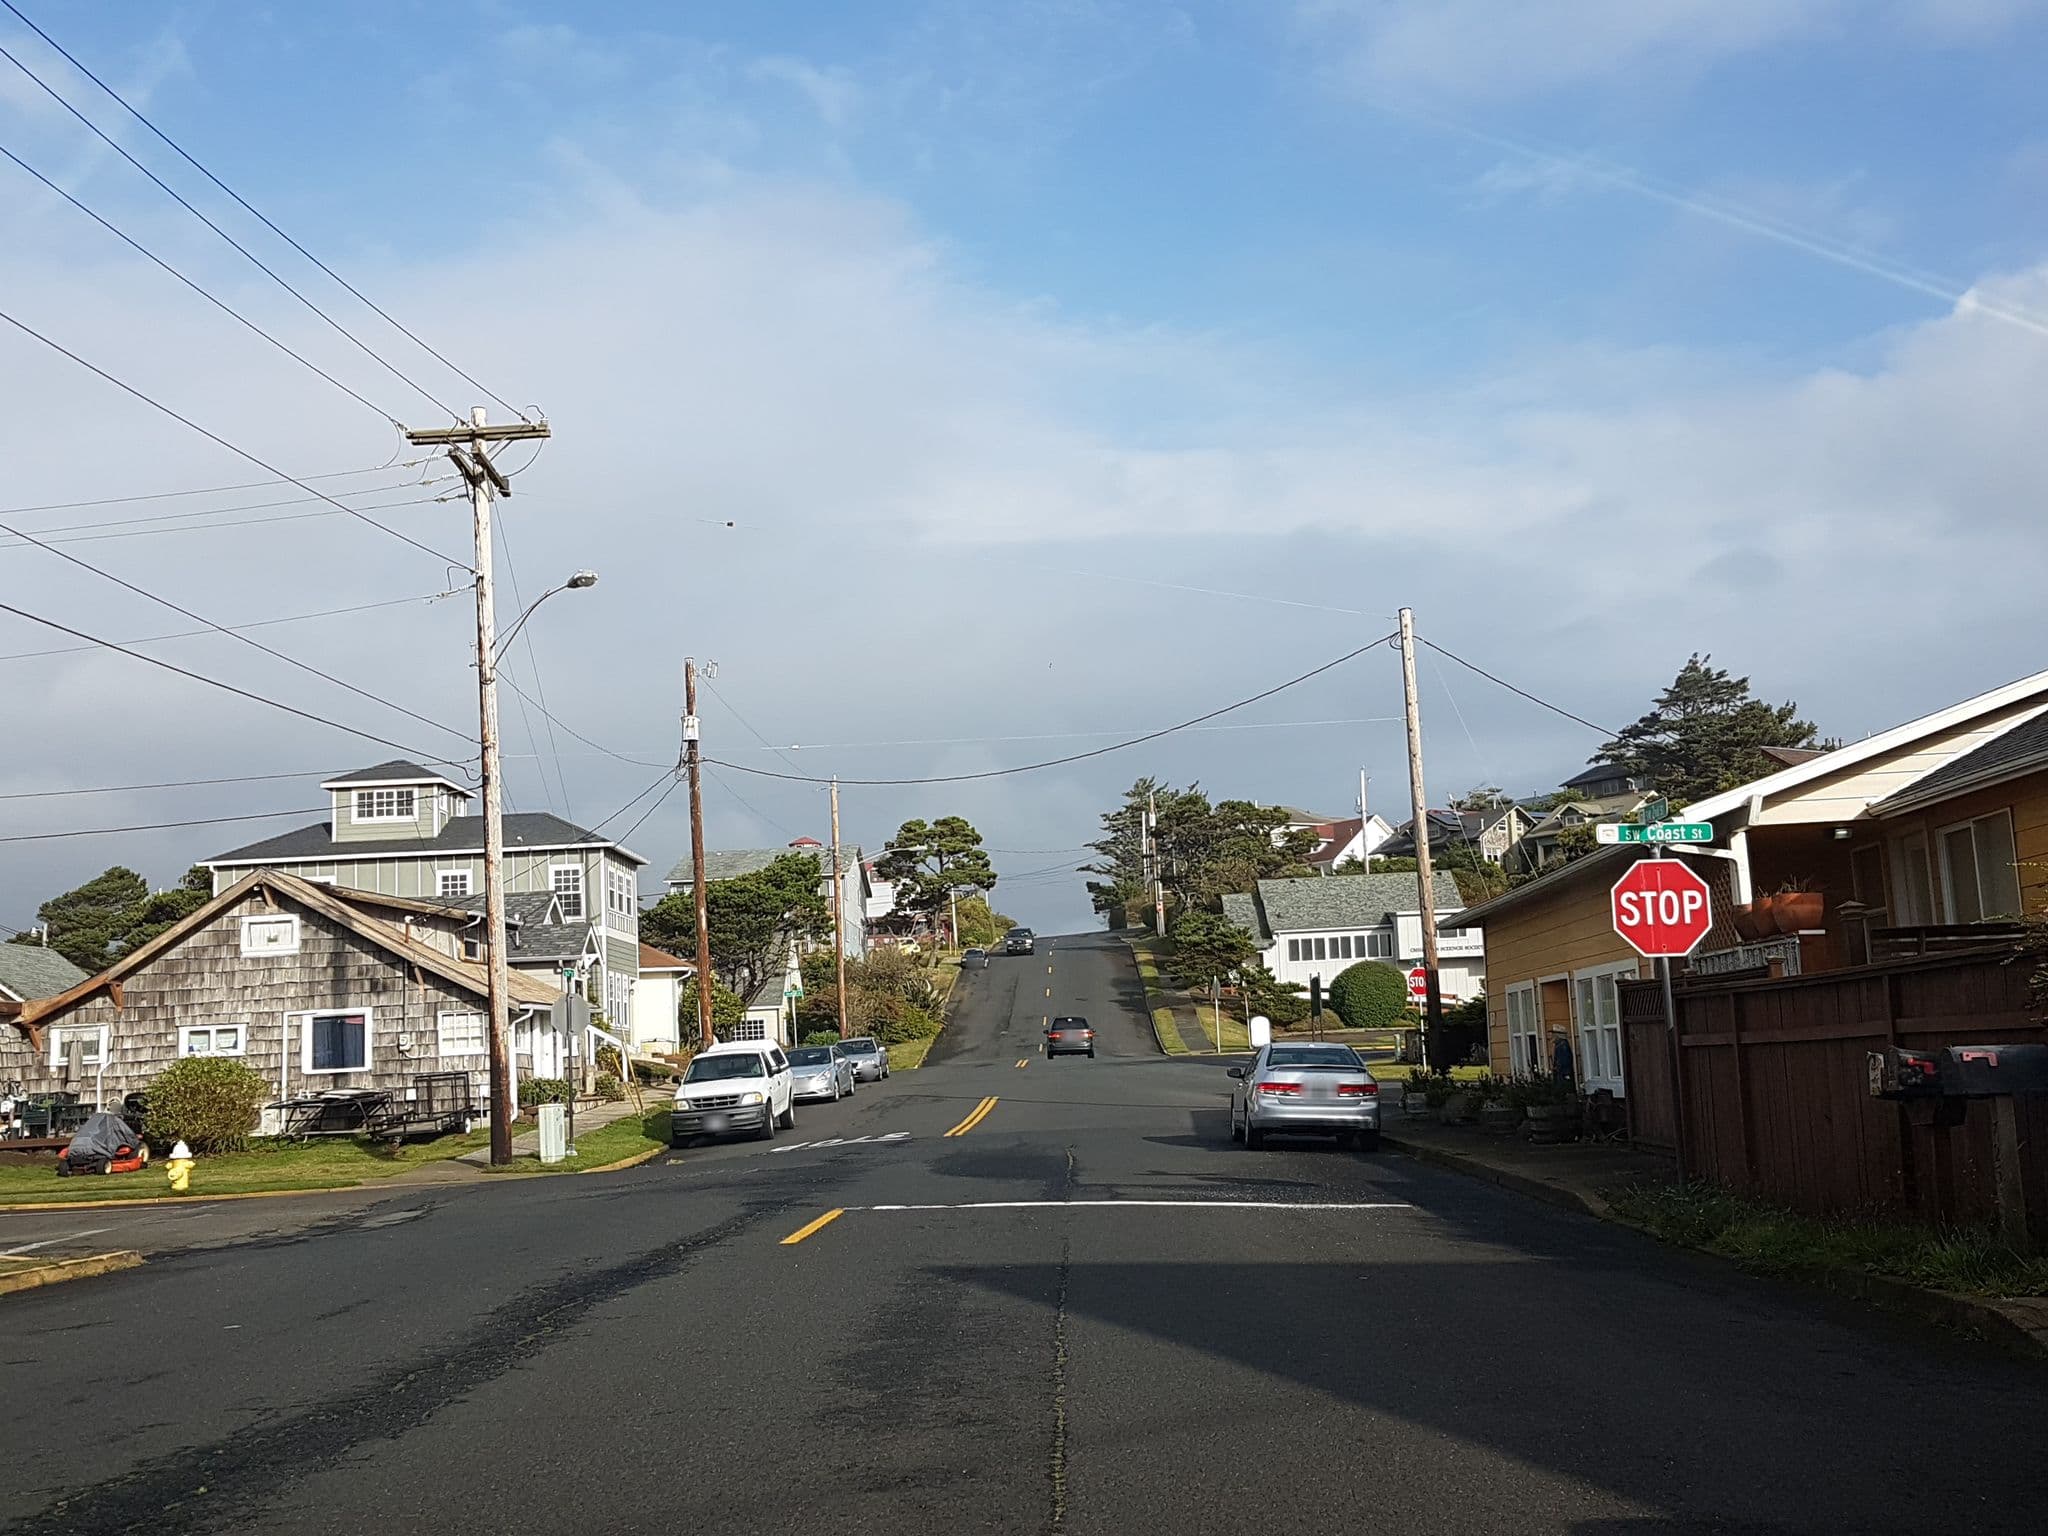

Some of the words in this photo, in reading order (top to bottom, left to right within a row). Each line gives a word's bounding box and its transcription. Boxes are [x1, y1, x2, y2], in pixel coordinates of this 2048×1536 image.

[1625, 830, 1640, 841] SW
[1647, 826, 1686, 840] Coast
[1691, 828, 1703, 839] St
[1620, 890, 1702, 926] STOP
